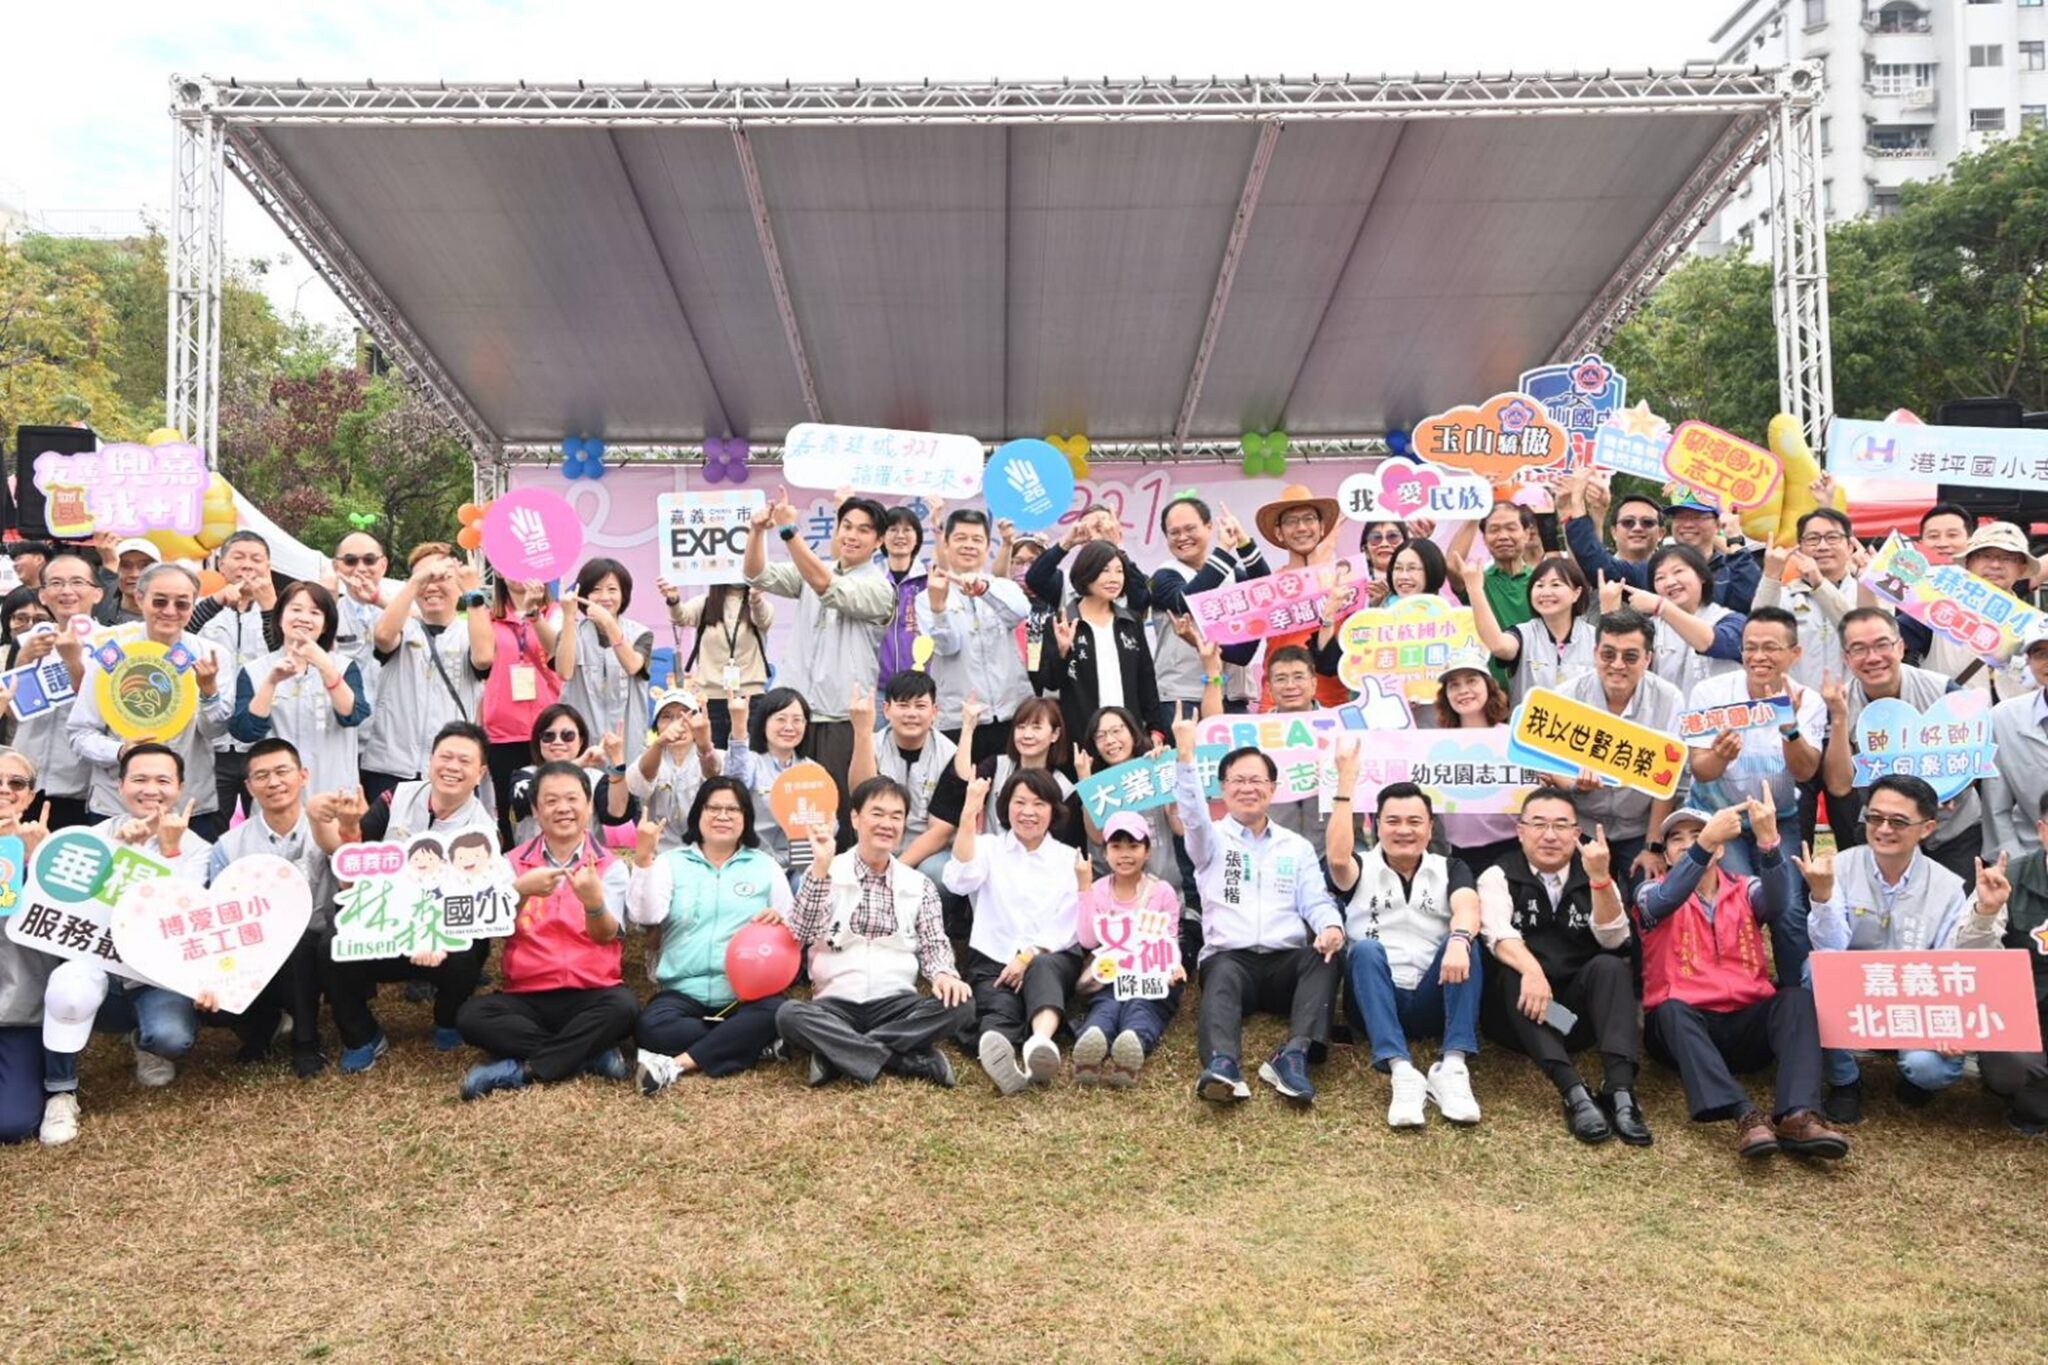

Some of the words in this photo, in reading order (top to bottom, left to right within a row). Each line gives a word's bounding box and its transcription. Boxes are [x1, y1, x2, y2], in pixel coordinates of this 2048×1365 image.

[1349, 479, 1485, 515] 我愛民族
[1526, 705, 1657, 778] 我以世賢為榮
[344, 854, 401, 872] 嘉義市
[159, 895, 271, 939] 博愛國小
[181, 921, 264, 961] 志工團
[336, 940, 396, 957] Linsen
[1861, 962, 1976, 997] 嘉義市
[1848, 1004, 2005, 1039] 北園國小
